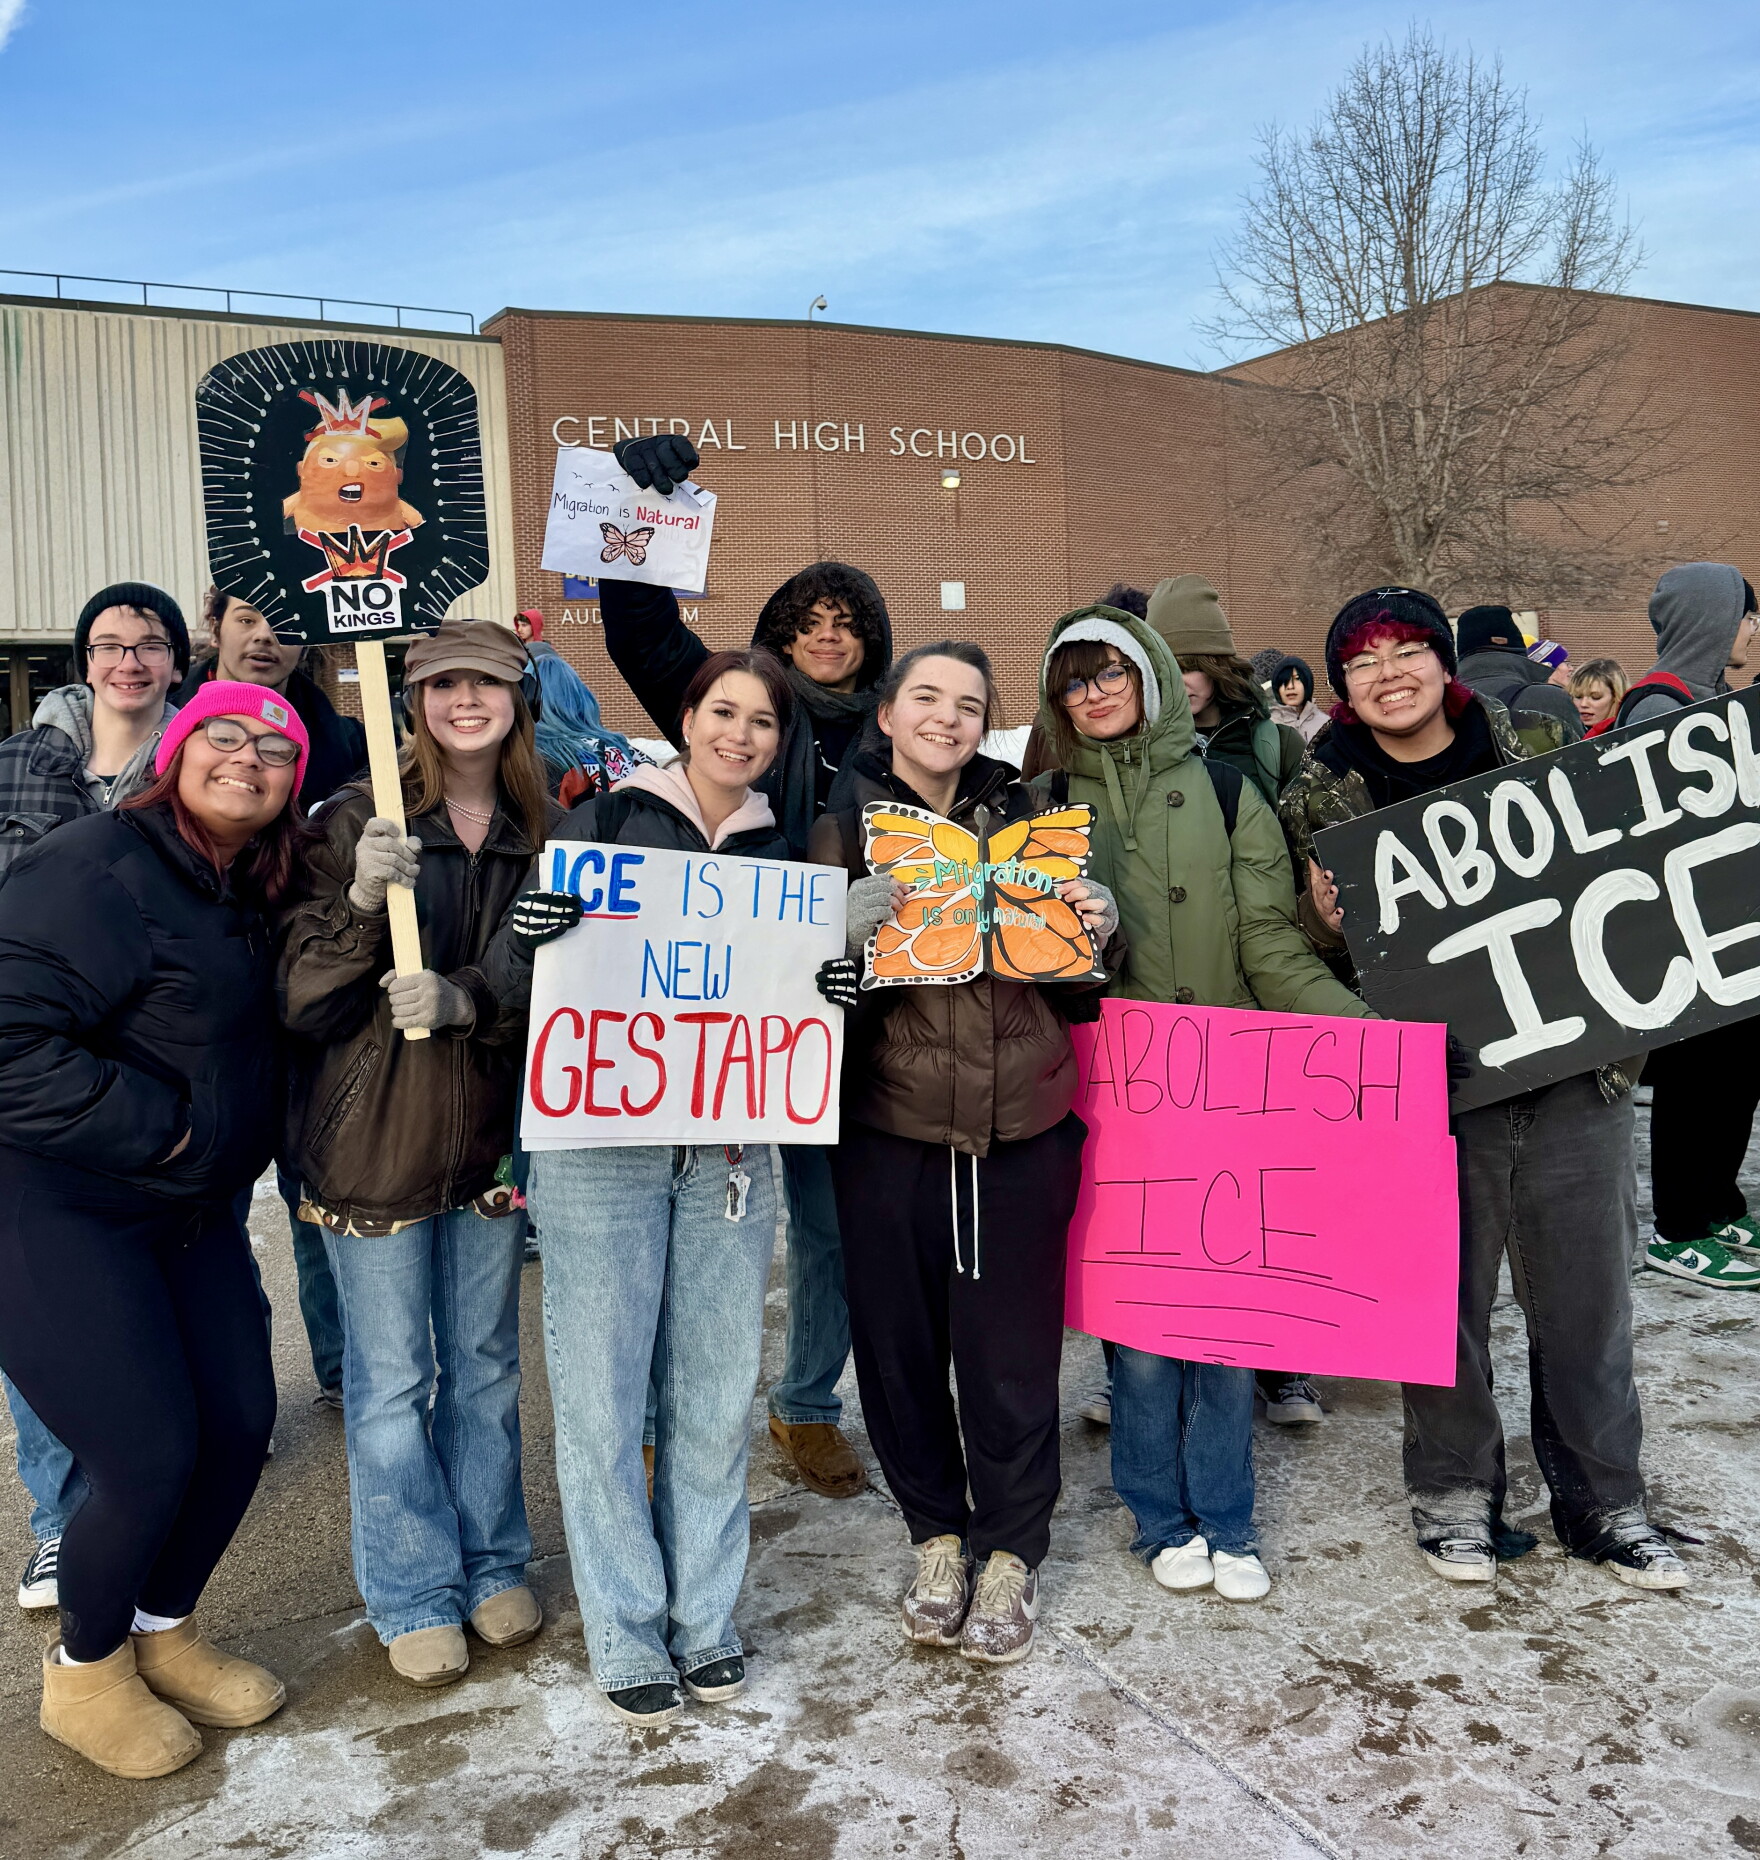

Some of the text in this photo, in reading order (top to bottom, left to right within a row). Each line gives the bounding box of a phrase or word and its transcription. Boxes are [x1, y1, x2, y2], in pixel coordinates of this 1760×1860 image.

[552, 416, 1037, 465] CENTRAL HIGH SCHOOL
[553, 492, 700, 530] Migration is Natural
[331, 582, 393, 613] NO
[333, 611, 396, 628] KINGS
[551, 848, 831, 926] ICE IS THE
[934, 856, 1053, 899] Migration
[953, 905, 990, 933] only
[993, 906, 1046, 931] natural
[1428, 822, 1760, 1067] ICE
[641, 939, 732, 1001] NEW
[530, 1007, 832, 1125] GESTAPO
[1085, 1009, 1402, 1122] ABOLISH
[1094, 1168, 1333, 1280] ICE
